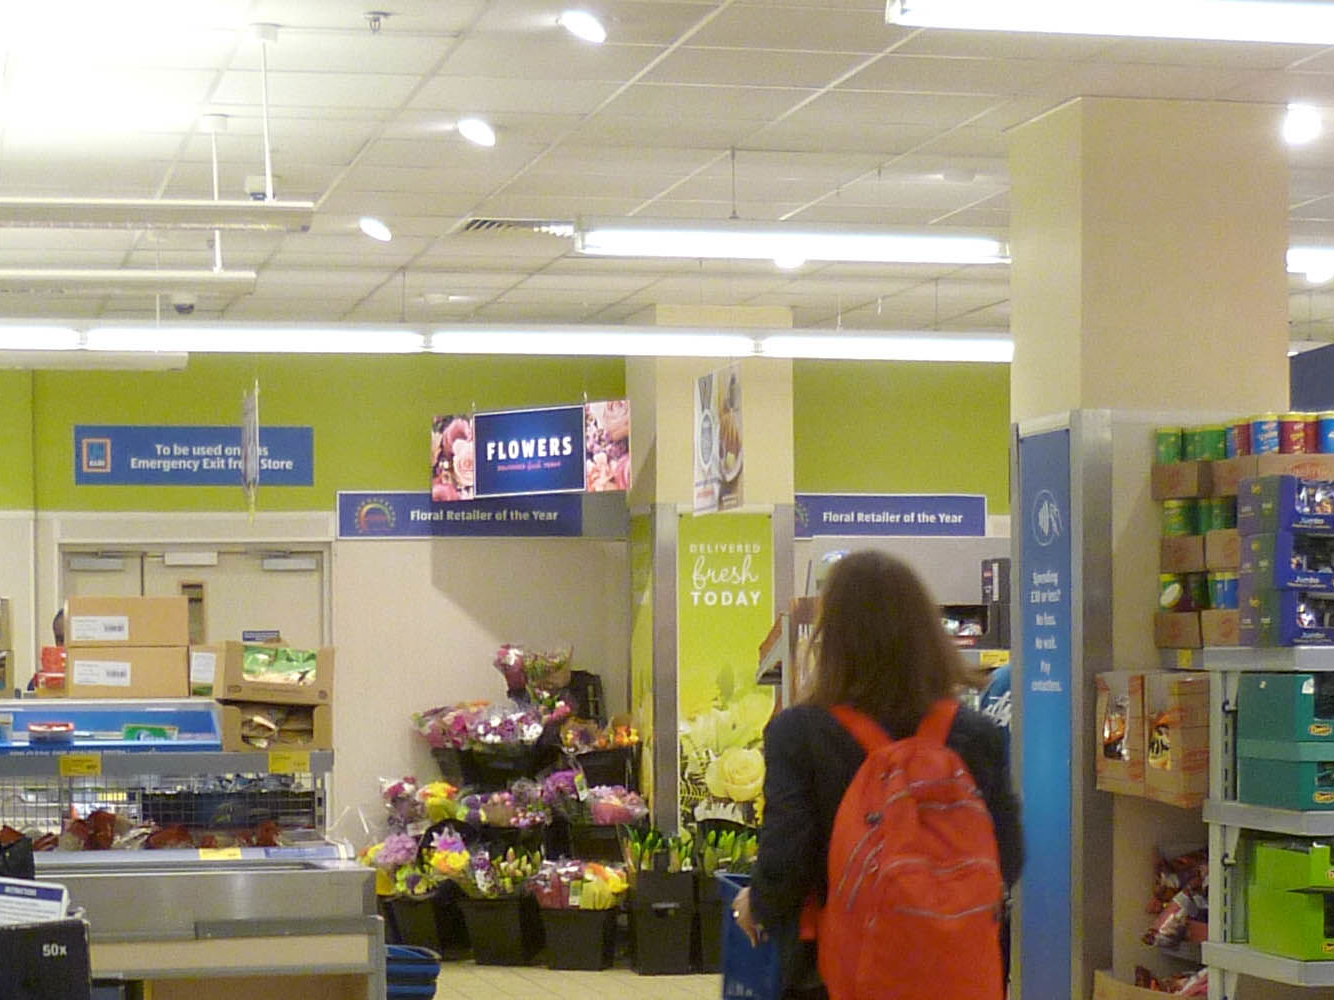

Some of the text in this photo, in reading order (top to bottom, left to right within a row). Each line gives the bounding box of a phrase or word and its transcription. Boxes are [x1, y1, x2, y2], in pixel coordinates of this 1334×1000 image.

[154, 443, 221, 456] To be used
[486, 436, 573, 461] FLOWERS
[130, 458, 294, 471] Emergency Exit Store
[410, 509, 558, 521] Floral Retailer of the Year
[822, 512, 964, 525] Floral Retailer of the Year
[689, 543, 761, 553] DELIVERED
[691, 554, 759, 590] fresh
[1032, 568, 1059, 587] Spending
[690, 591, 761, 607] TODAY
[42, 943, 67, 958] 50x
